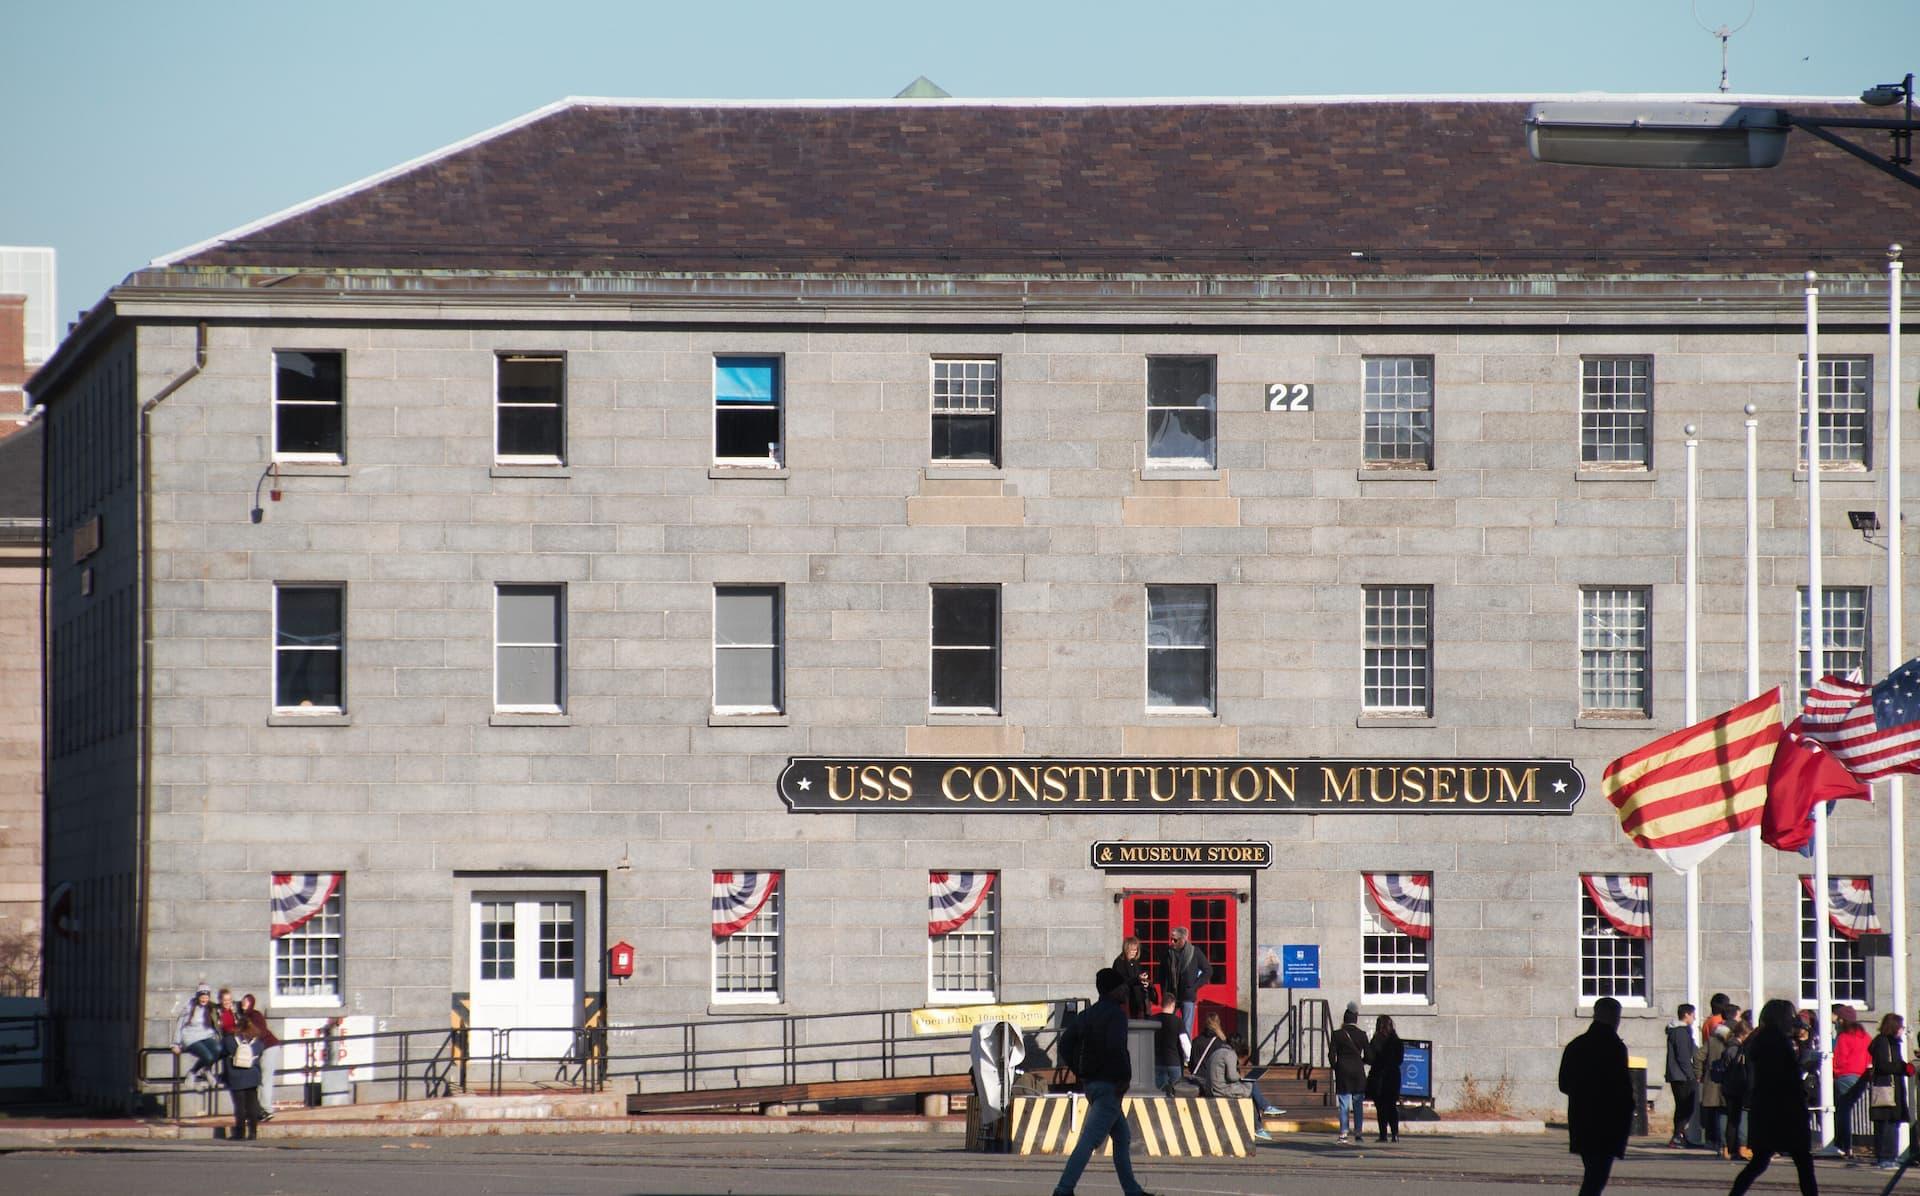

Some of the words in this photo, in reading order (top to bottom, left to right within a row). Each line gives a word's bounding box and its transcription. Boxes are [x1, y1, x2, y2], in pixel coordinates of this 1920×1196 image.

[1269, 383, 1309, 411] 22
[824, 765, 913, 802] USS
[941, 765, 1299, 803] CONSTITUTION
[1320, 766, 1541, 804] MUSEUM
[1100, 847, 1113, 862] &
[1119, 847, 1202, 862] MUSEUM
[1207, 847, 1265, 862] STORE
[947, 1014, 974, 1026] Daily
[1007, 1013, 1018, 1021] to
